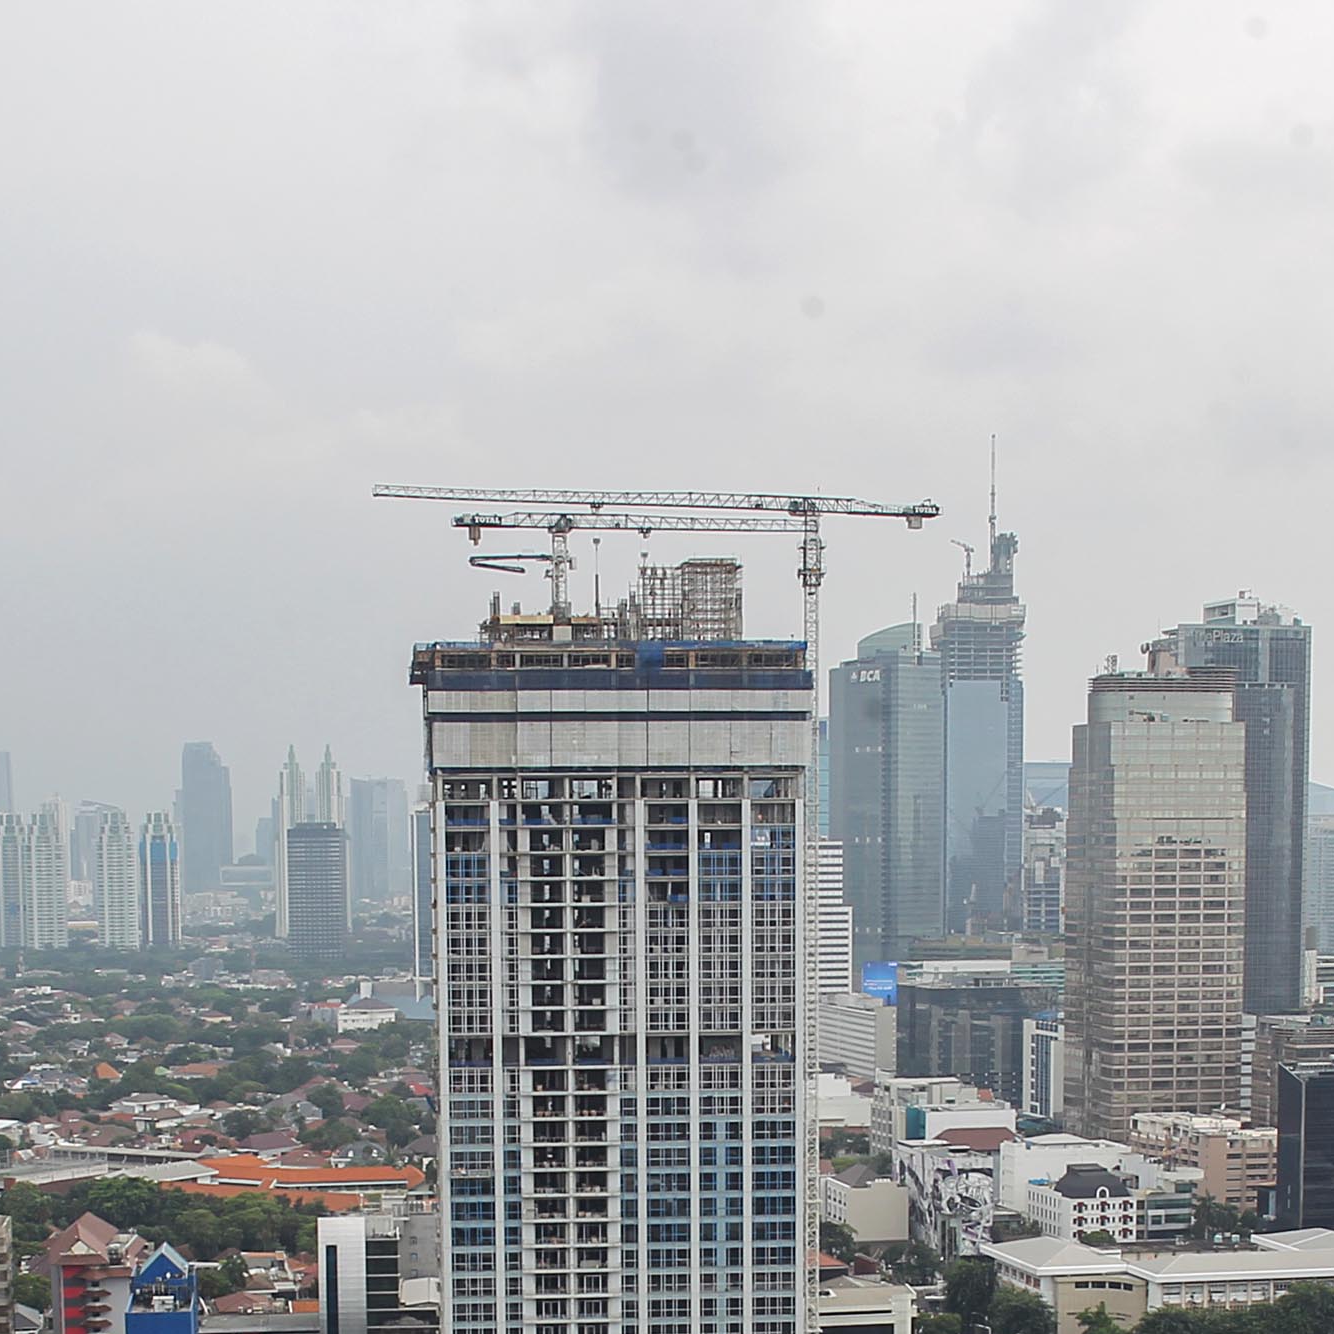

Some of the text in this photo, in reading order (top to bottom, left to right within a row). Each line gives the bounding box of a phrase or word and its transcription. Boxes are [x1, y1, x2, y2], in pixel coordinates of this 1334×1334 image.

[914, 506, 937, 514] TOTAL
[474, 516, 500, 524] TOTAL
[859, 669, 881, 682] BCA
